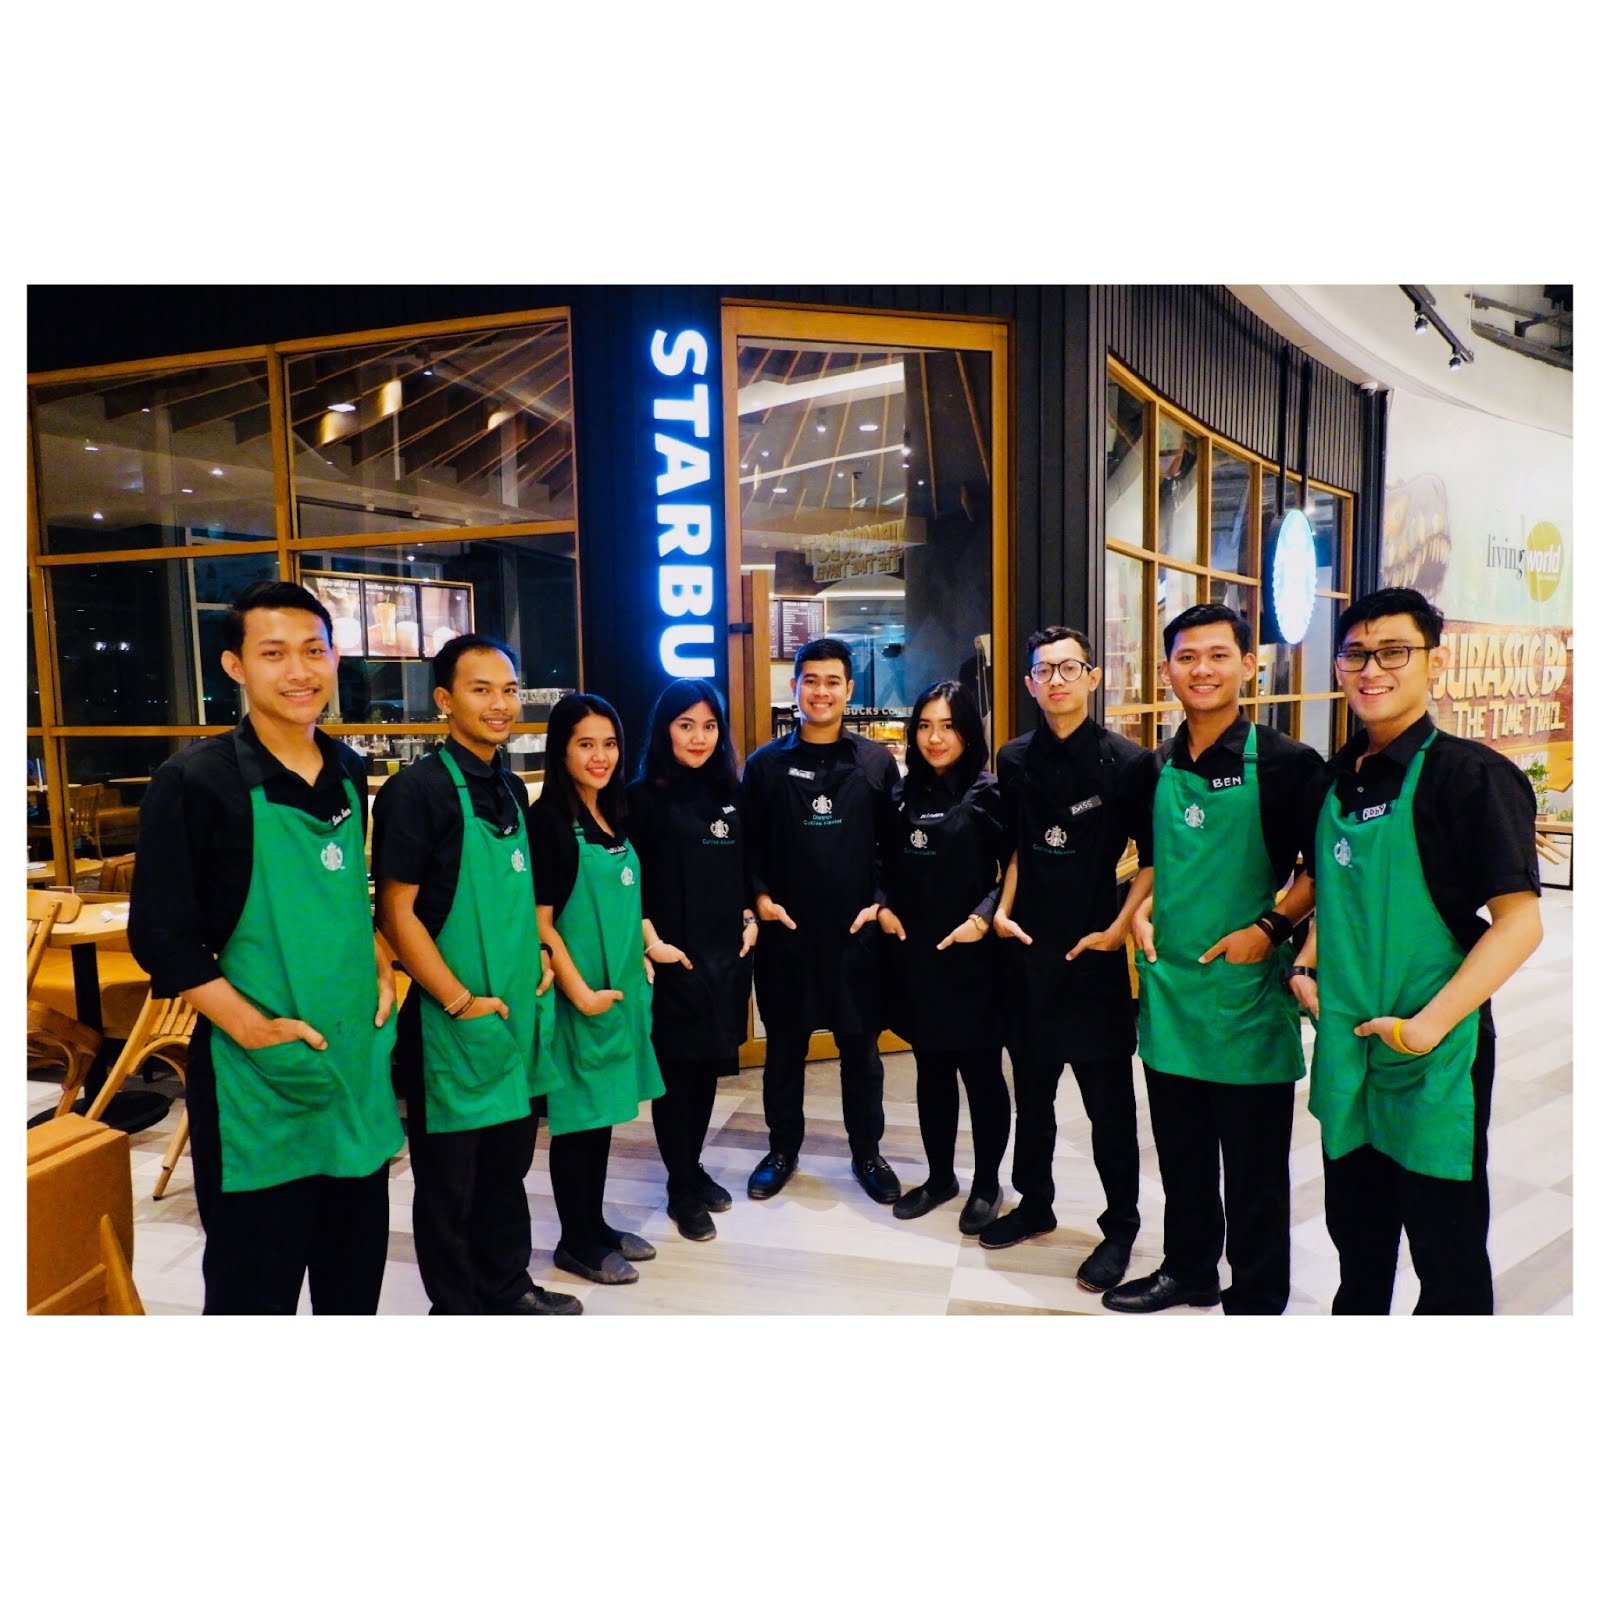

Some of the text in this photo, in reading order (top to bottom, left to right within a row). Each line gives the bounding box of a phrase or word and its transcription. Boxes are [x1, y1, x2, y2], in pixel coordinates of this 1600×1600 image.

[1486, 533, 1561, 581] living world
[1431, 632, 1541, 700] JURASSIC
[1453, 701, 1488, 740] THE
[1488, 700, 1526, 740] TIME
[1212, 776, 1242, 788] BEN
[1071, 800, 1093, 815] BASS
